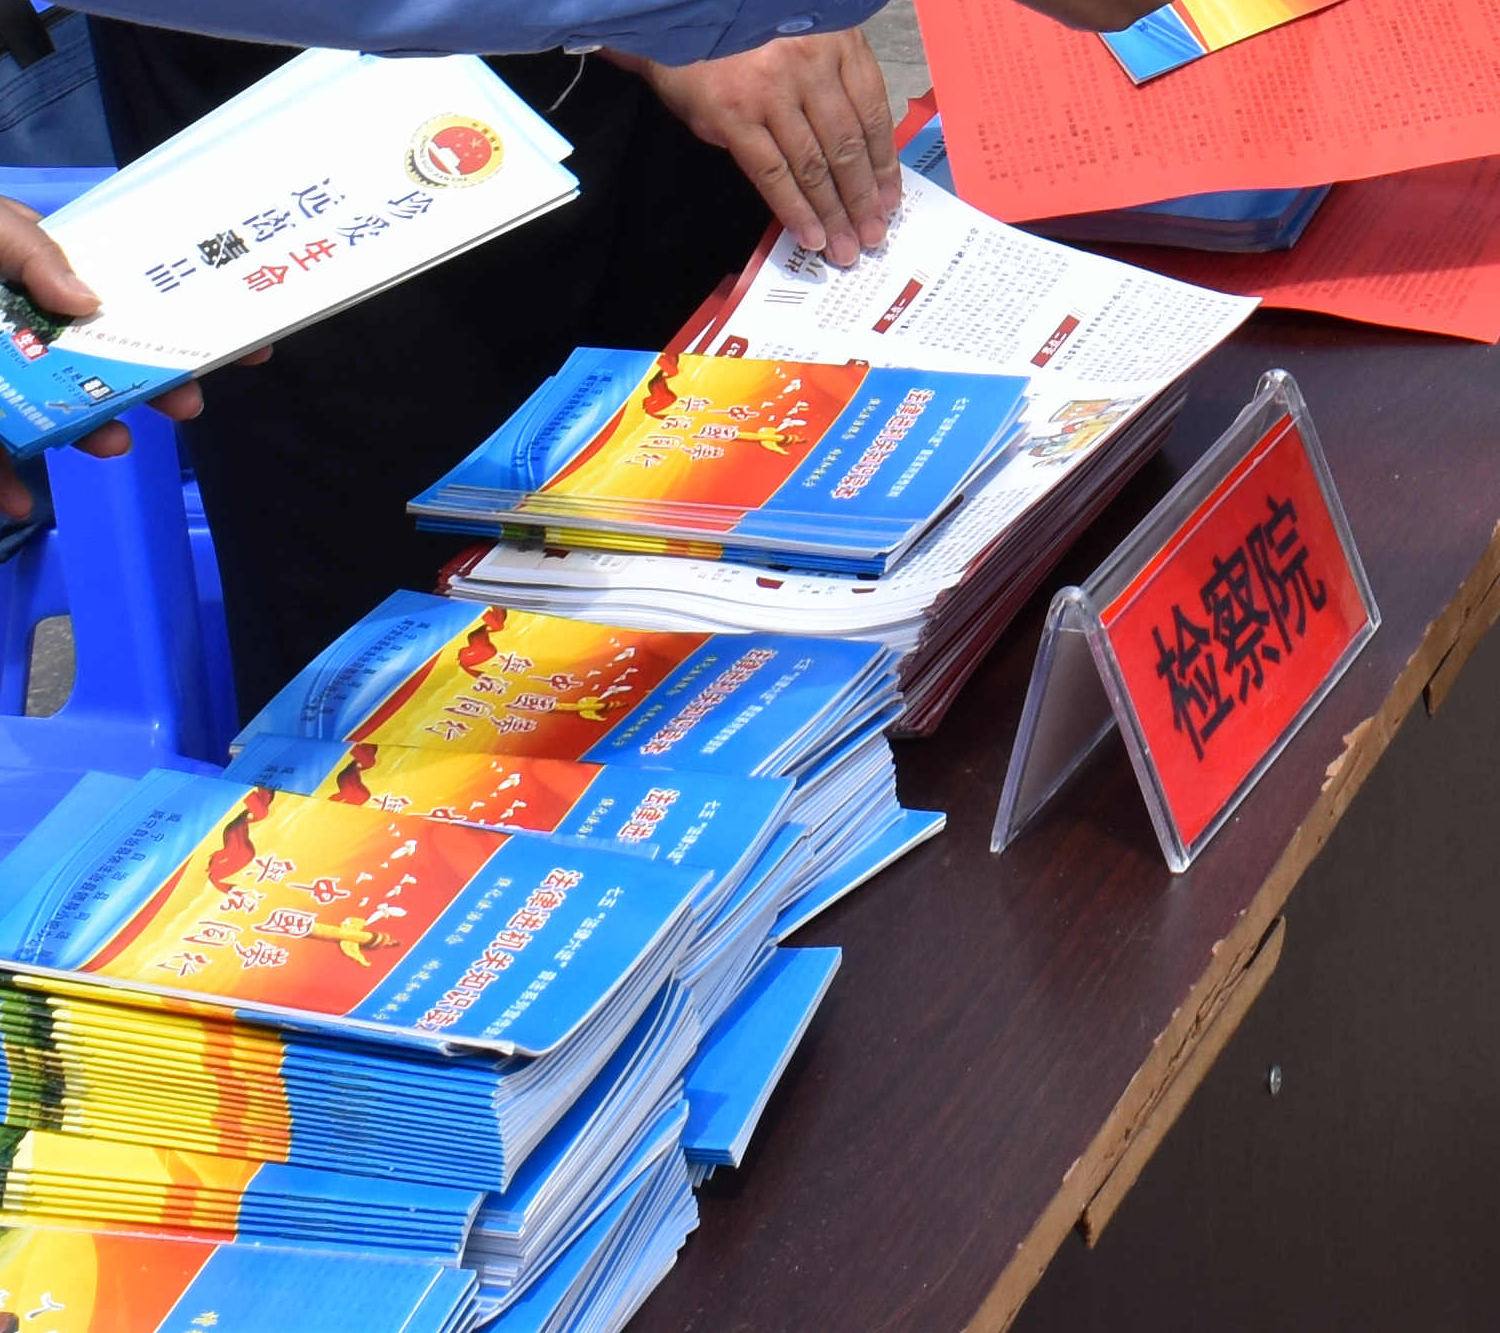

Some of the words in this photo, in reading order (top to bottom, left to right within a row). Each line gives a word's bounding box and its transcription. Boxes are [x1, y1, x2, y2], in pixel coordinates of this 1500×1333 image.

[137, 174, 355, 296] 远离毒品
[234, 185, 443, 297] 珍爱生命
[1152, 493, 1327, 762] 检察院
